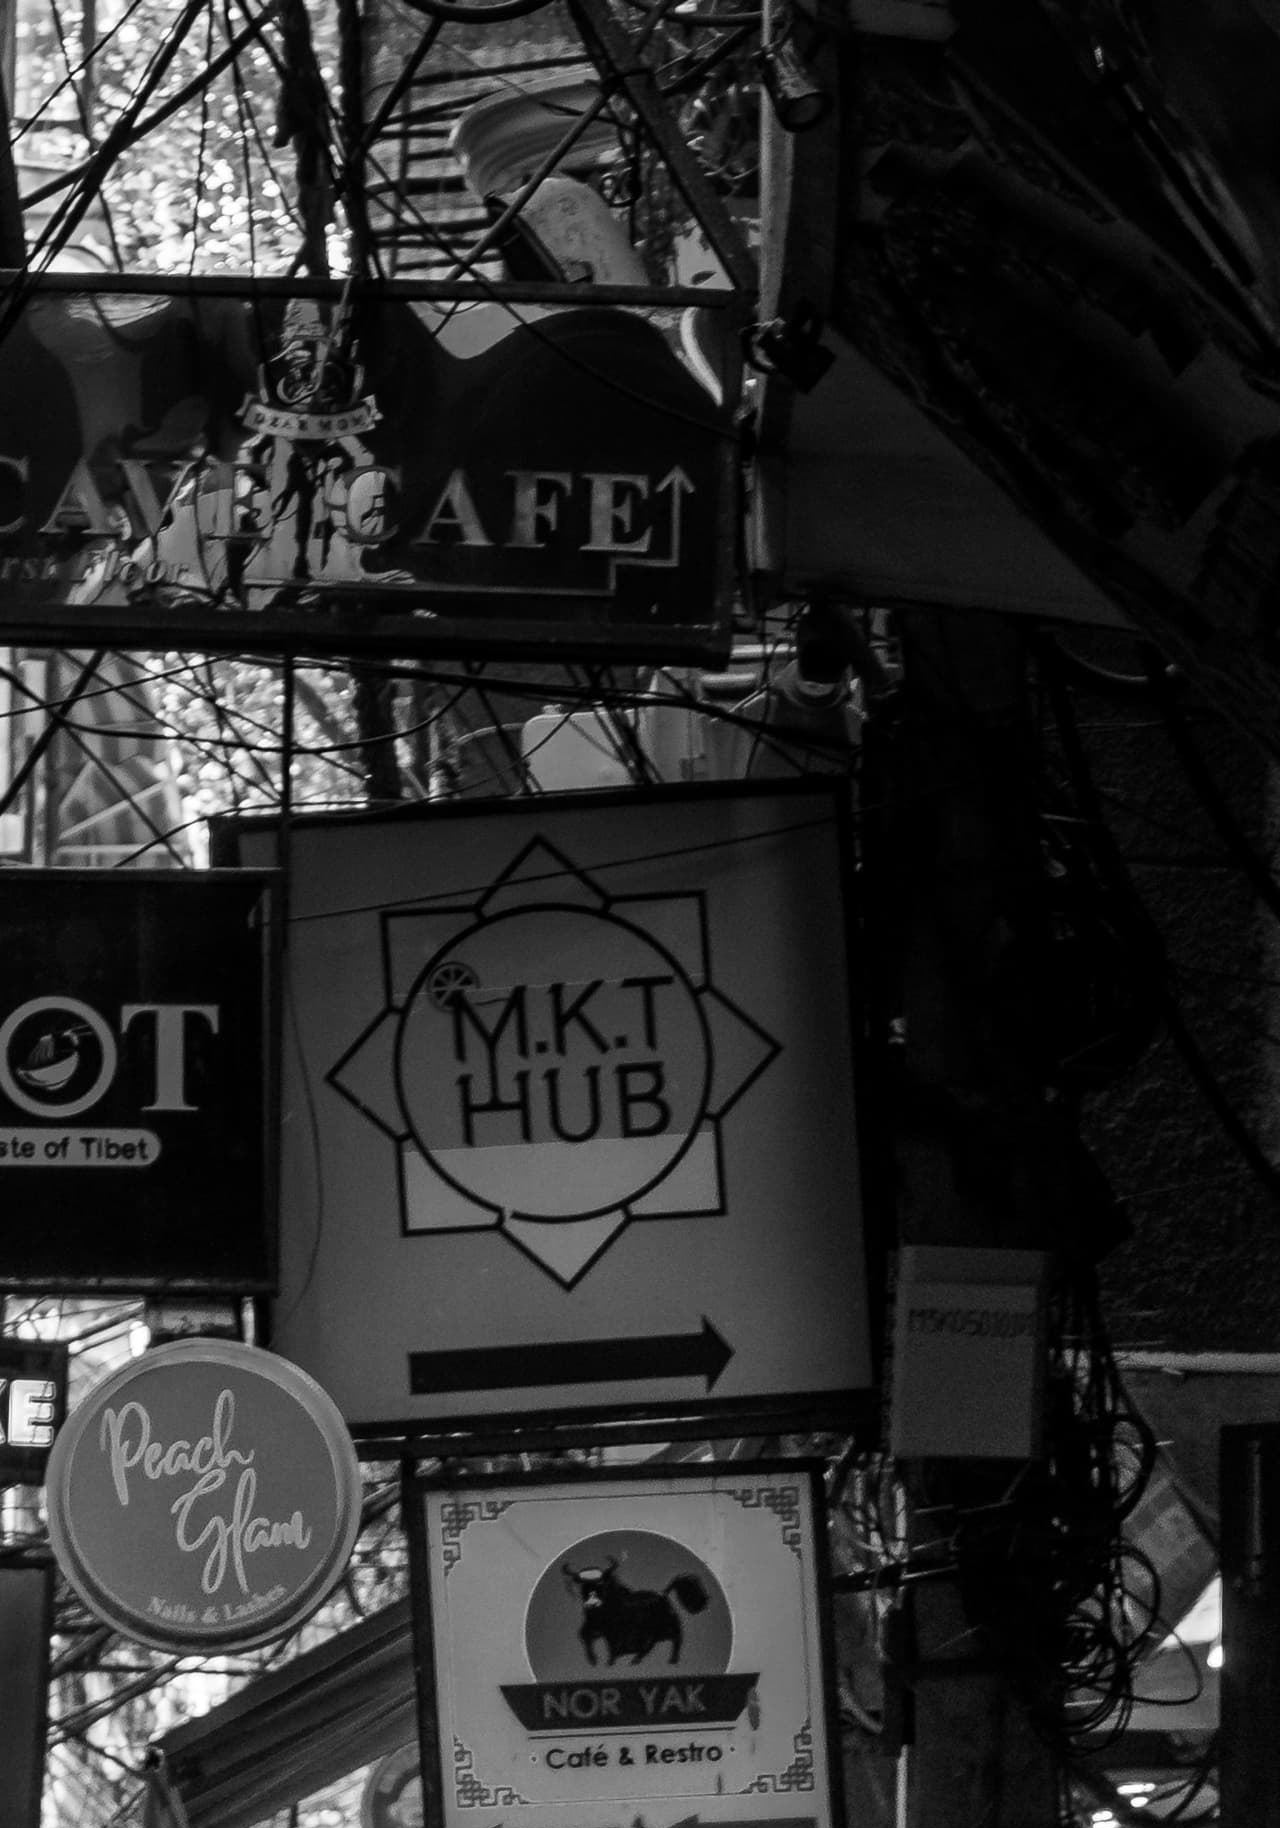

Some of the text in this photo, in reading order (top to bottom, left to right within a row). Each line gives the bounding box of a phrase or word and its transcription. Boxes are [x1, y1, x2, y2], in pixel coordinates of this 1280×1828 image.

[341, 467, 654, 553] CAFE
[450, 975, 673, 1062] M.K.T
[456, 1062, 672, 1146] HUB
[43, 1136, 69, 1159] of
[80, 1137, 148, 1160] Tibet
[100, 1389, 255, 1506] Peach
[171, 1468, 313, 1594] Glam
[542, 1683, 707, 1719] NOR YAK
[546, 1742, 723, 1769] Café & Restro
